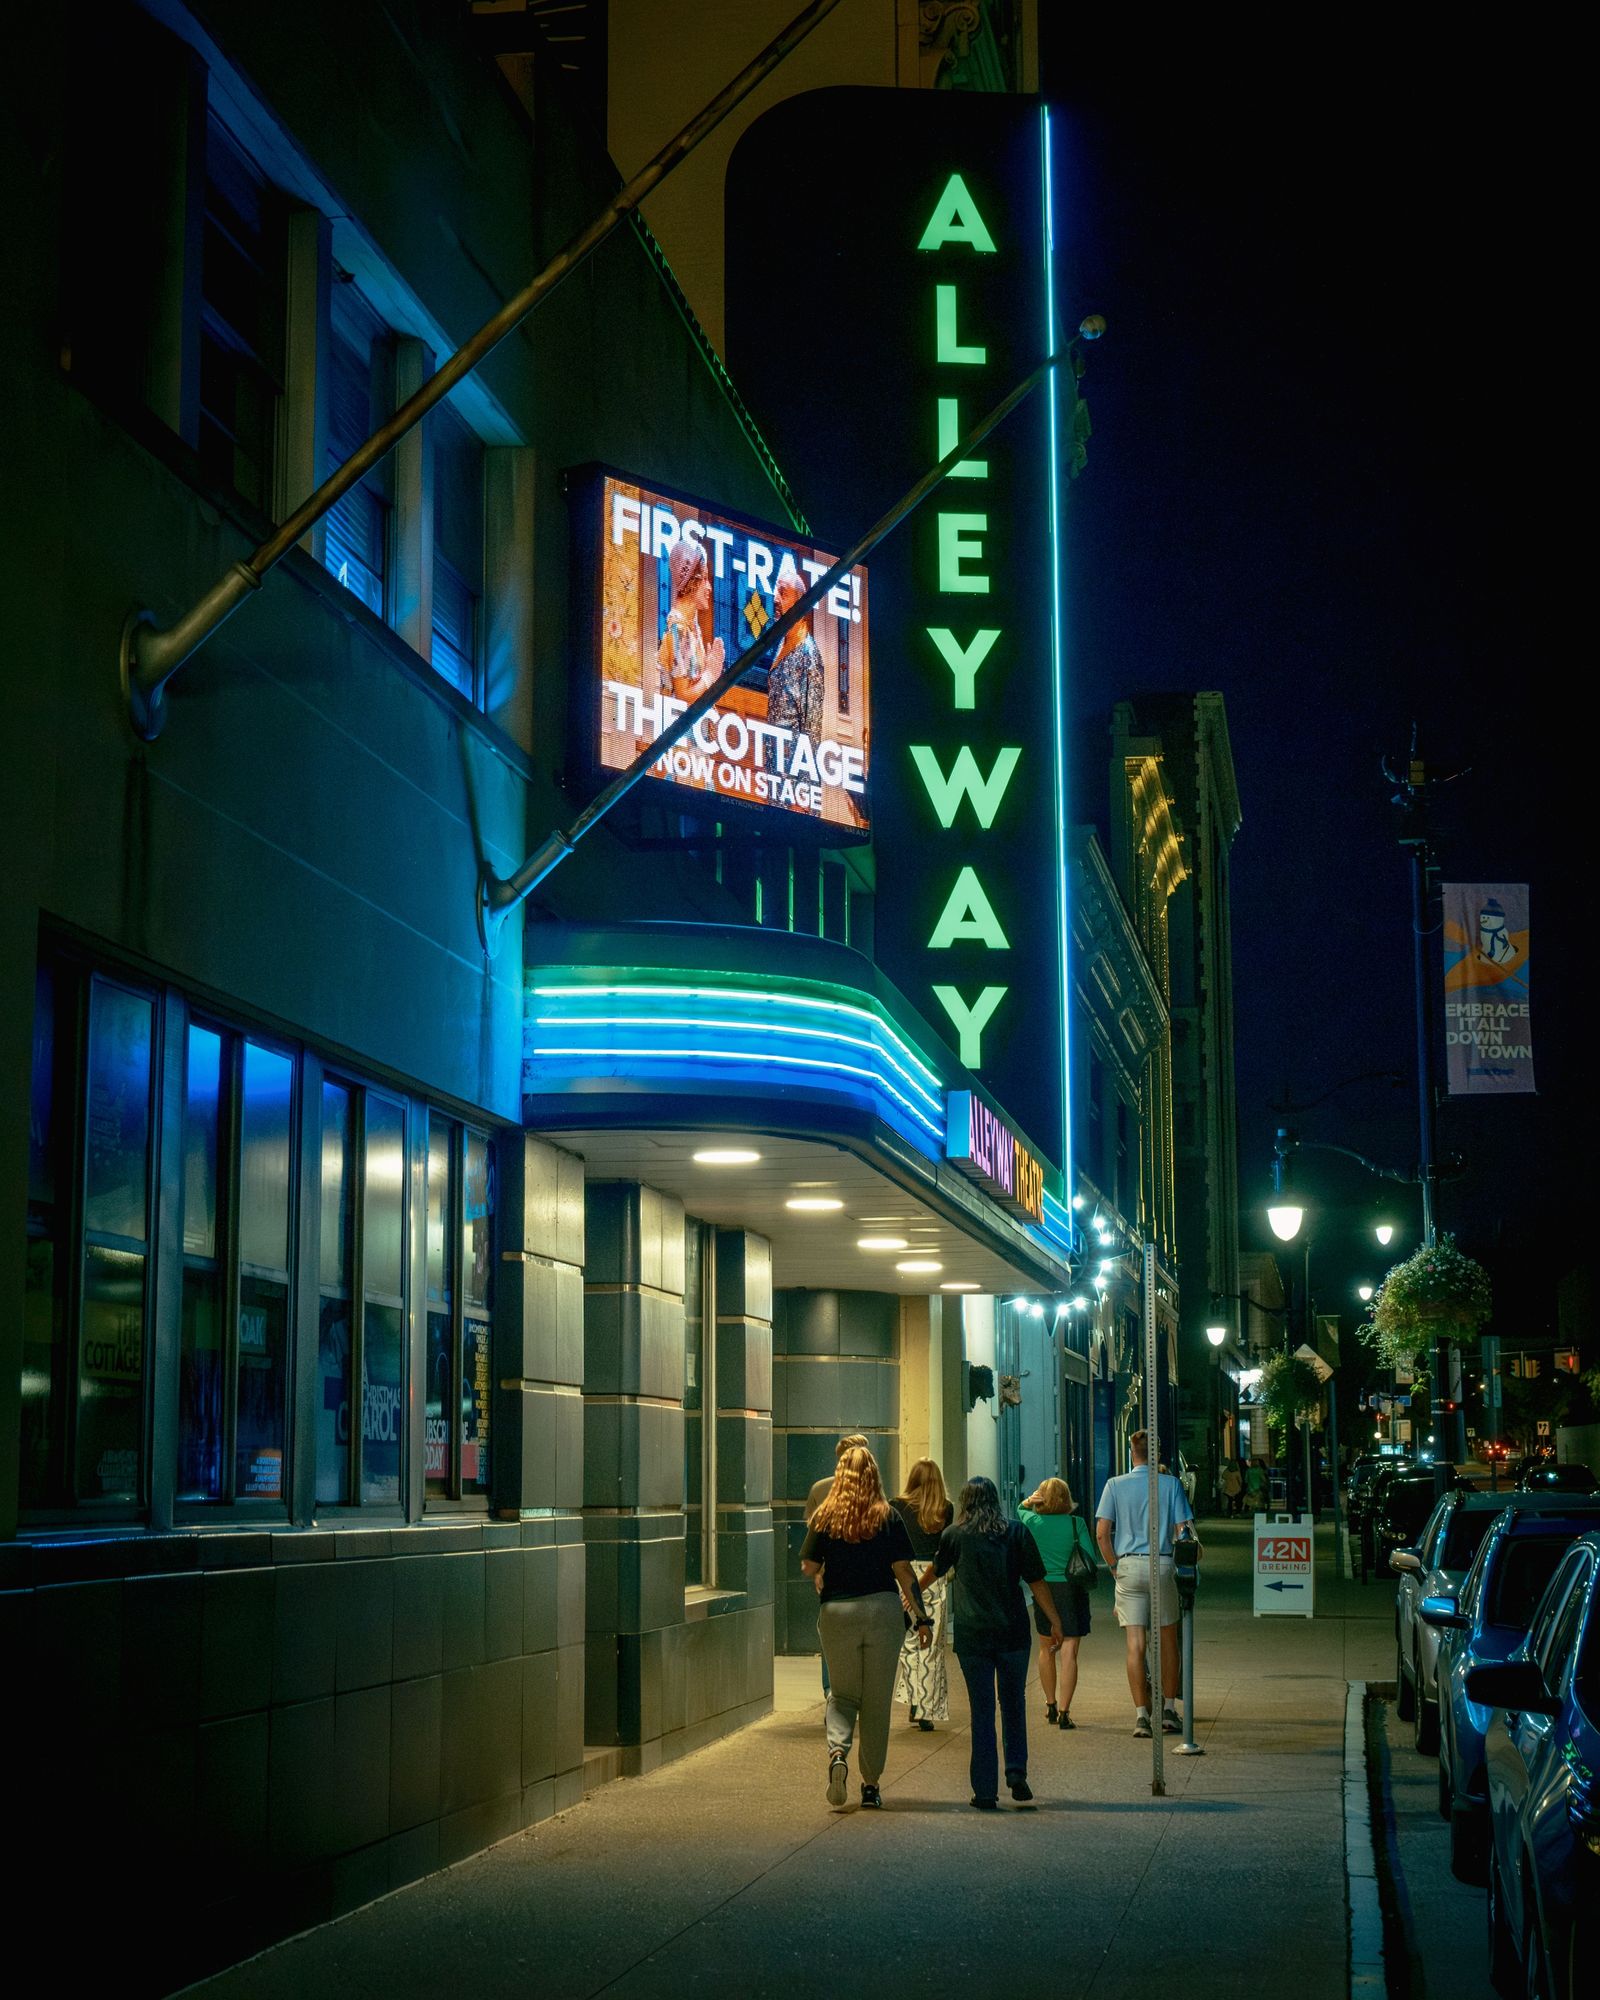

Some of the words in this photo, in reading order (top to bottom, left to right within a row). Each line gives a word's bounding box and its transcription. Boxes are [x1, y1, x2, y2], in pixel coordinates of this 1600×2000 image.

[612, 493, 861, 624] FIRST-RATE!
[910, 173, 1022, 1070] ALLEYWAY
[692, 709, 864, 793] COTTAGE
[656, 748, 715, 782] NOW
[717, 762, 751, 794] ON
[754, 771, 822, 811] STAGE
[1446, 1003, 1529, 1017] EMBRACE
[1459, 1017, 1476, 1031] IT
[1476, 1017, 1510, 1031] ALL
[1447, 1031, 1502, 1045] DOWN
[1478, 1045, 1532, 1059] TOWN
[969, 1090, 1014, 1196] ALLEYWAY
[85, 1341, 140, 1374] COTTAGE
[1262, 1541, 1307, 1559] 42N
[1262, 1563, 1307, 1571] BREWING
